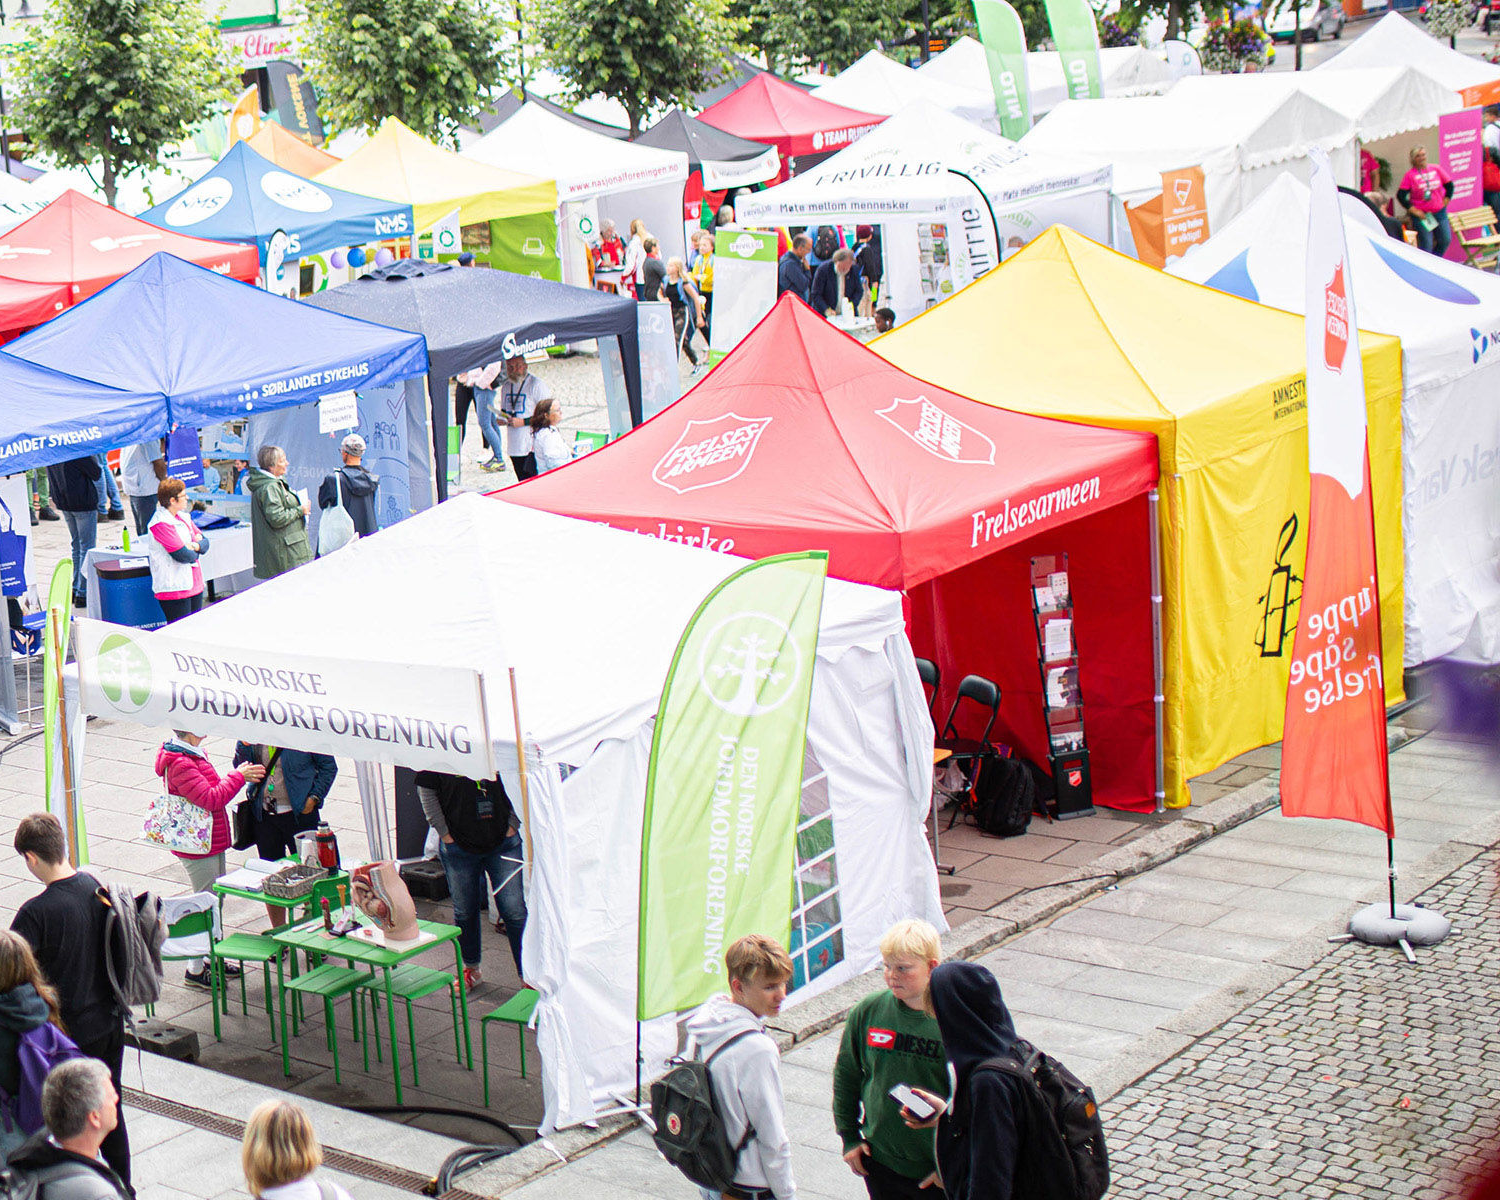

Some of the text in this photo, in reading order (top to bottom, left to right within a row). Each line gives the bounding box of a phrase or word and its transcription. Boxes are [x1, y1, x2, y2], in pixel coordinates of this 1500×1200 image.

[824, 130, 847, 146] TEAM
[569, 163, 679, 193] www.nasjonalforeningen.no
[816, 162, 941, 186] FRIVILLIG
[779, 199, 909, 213] Møte mellom mennesker
[374, 213, 408, 235] NMS
[502, 332, 556, 360] Seniornett
[262, 362, 369, 397] SØRLANDET SYKEHUS
[1273, 379, 1307, 407] AMNESTY
[49, 426, 101, 448] SYKEHUS
[662, 441, 750, 480] ARMEEN
[970, 476, 1100, 548] Frelsesarmeen
[170, 652, 327, 696] DEN NORSKE
[168, 680, 472, 755] JORDMORFORENING
[734, 746, 760, 875] DEN NORSKE
[702, 732, 739, 977] JORDMORFORENING
